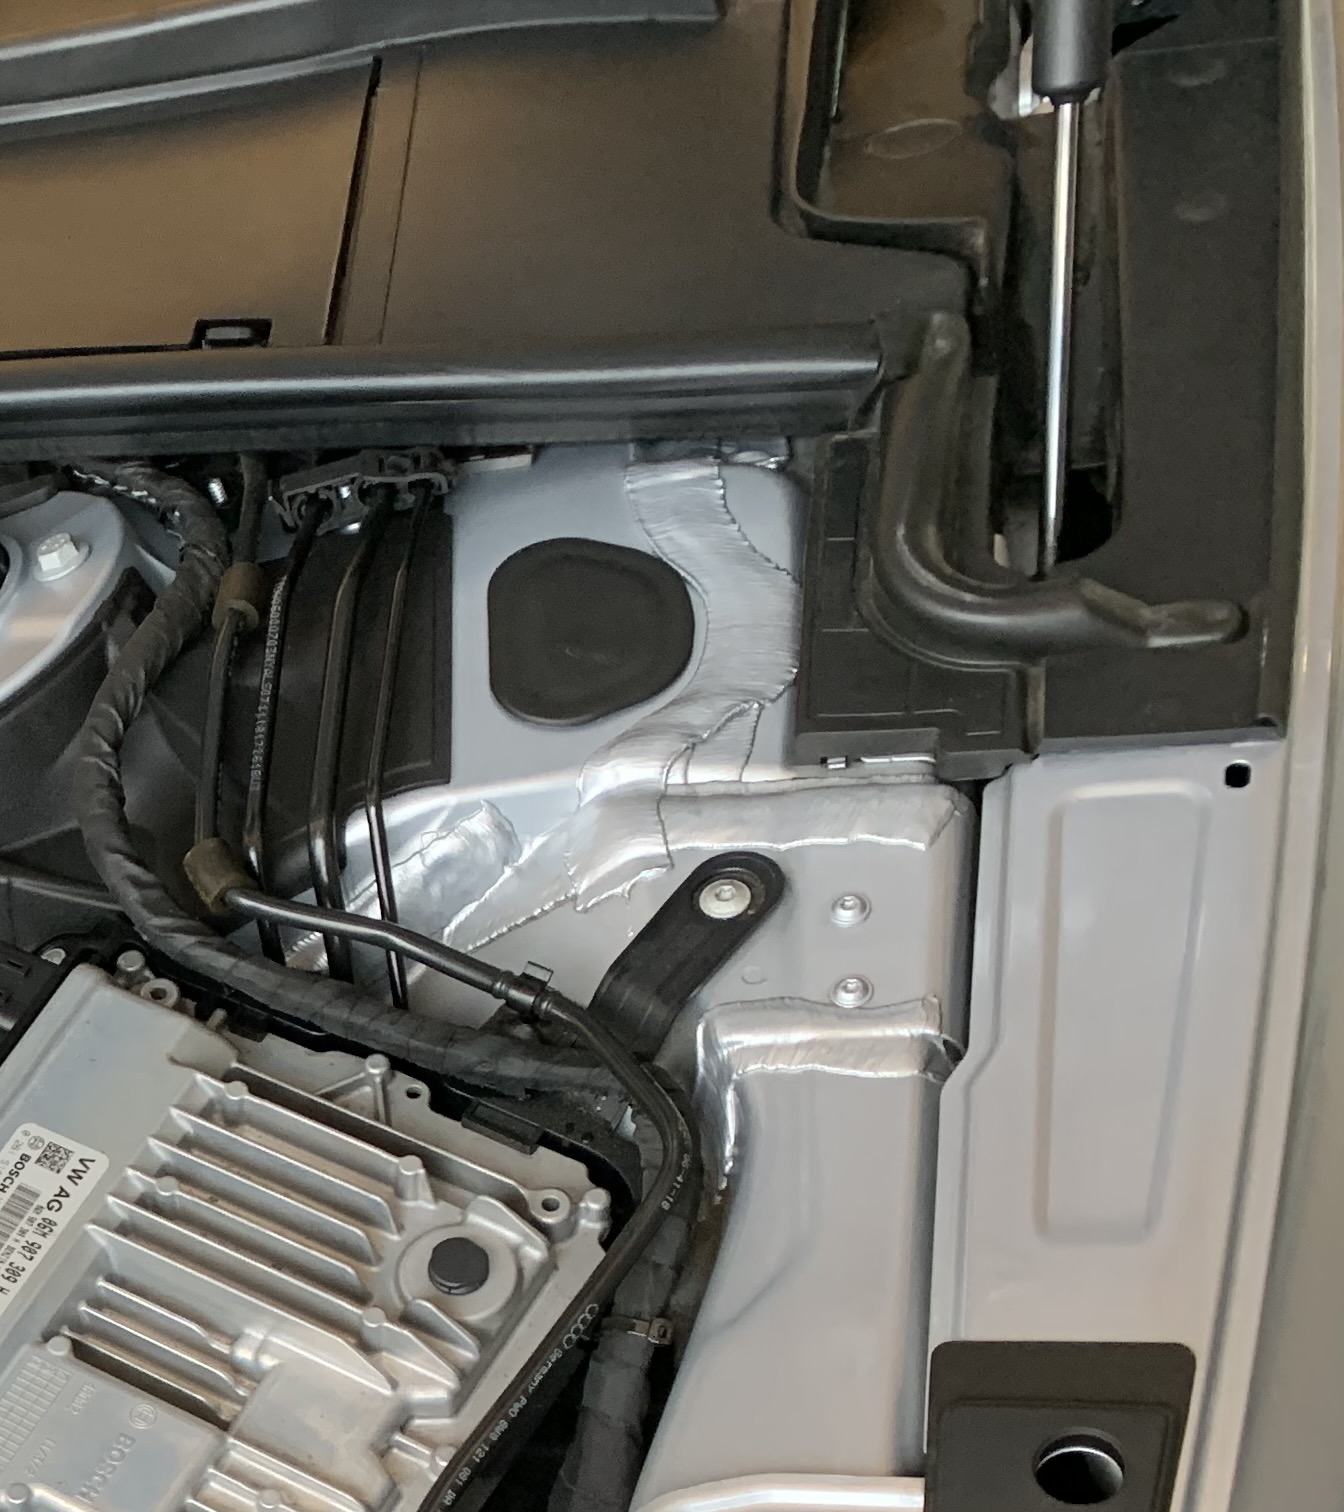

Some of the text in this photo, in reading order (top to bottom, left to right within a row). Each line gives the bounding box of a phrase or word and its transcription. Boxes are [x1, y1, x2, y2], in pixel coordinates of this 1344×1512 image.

[66, 1154, 94, 1184] VW
[45, 1187, 70, 1213] AG
[18, 1238, 40, 1260] 907
[1, 1260, 24, 1284] 309
[74, 1432, 136, 1504] BOSCH
